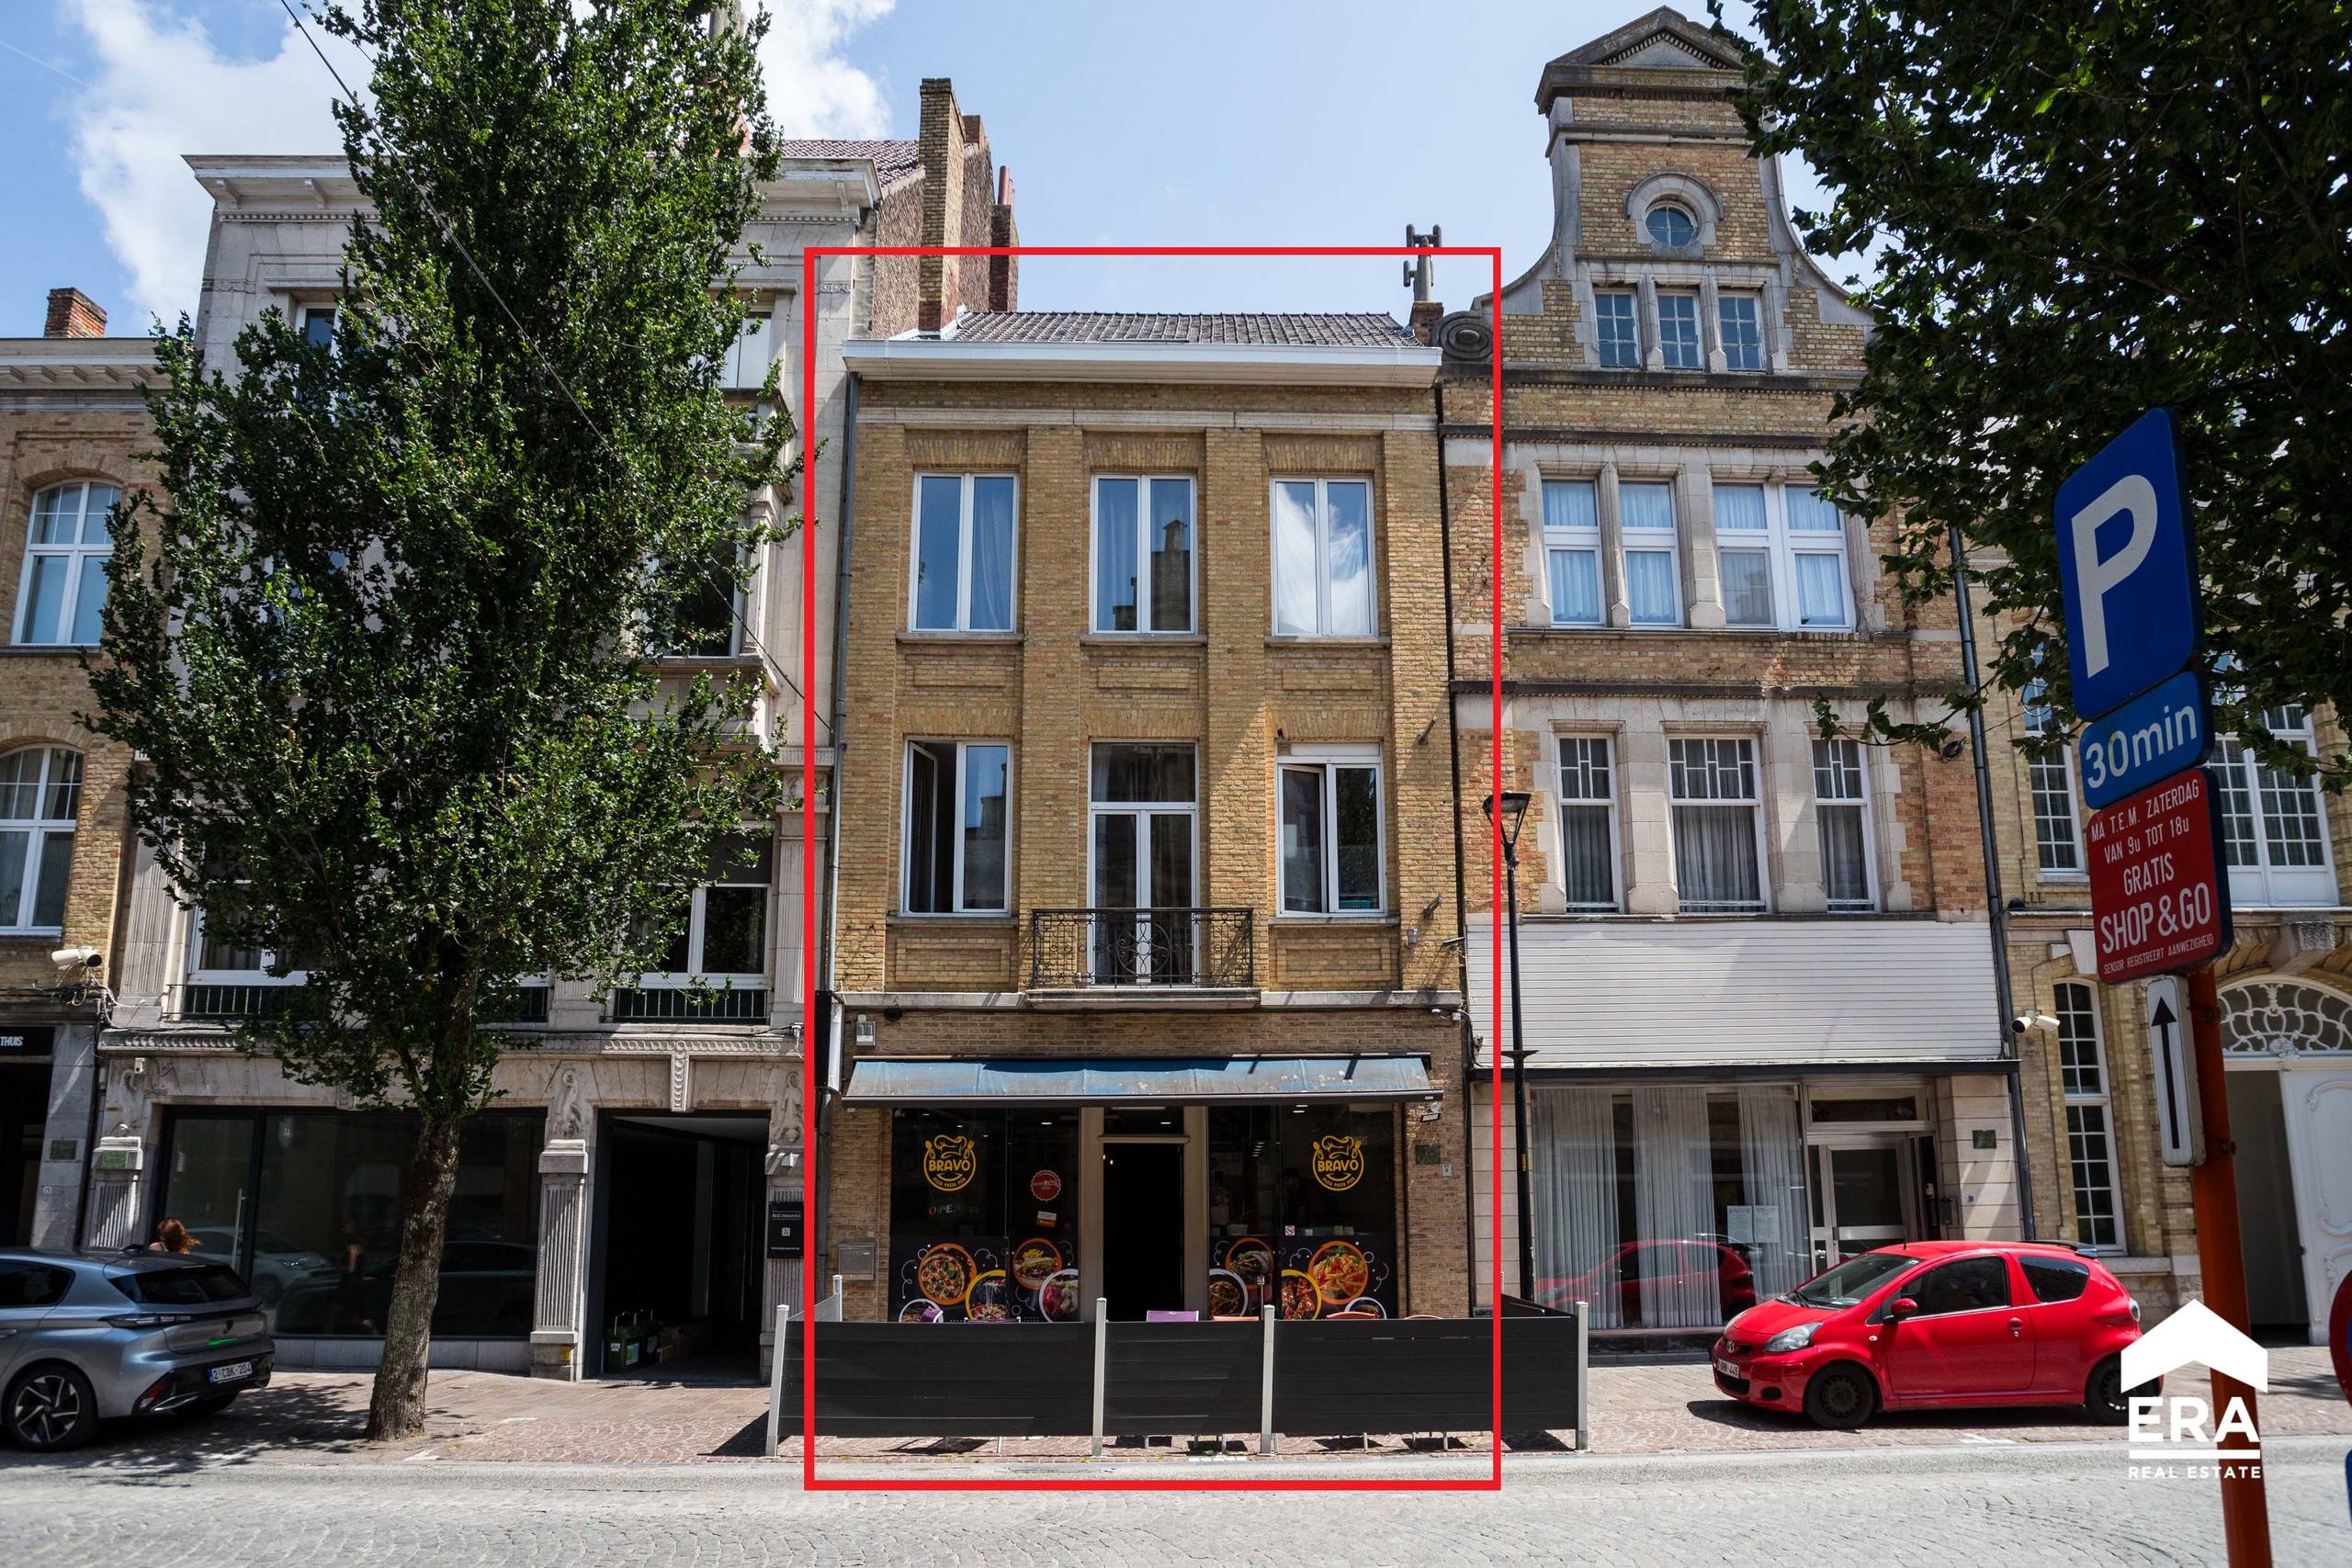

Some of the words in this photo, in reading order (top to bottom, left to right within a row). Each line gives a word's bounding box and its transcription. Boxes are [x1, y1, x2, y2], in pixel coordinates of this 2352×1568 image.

[2071, 474, 2158, 679] P
[2086, 705, 2198, 789] 30min
[2091, 821, 2106, 843] MA
[2109, 807, 2142, 833] T.E.M.
[2146, 779, 2199, 819] ZATERDAG
[2104, 840, 2123, 864] VAN
[2127, 836, 2141, 855] 9u
[2145, 824, 2164, 848] TOT
[2169, 816, 2190, 838] 18u
[2123, 852, 2175, 897] GRATIS
[2104, 961, 2125, 976] SENSOR
[2127, 947, 2165, 969] REGISTREERT
[2168, 933, 2214, 957] AANWEZIGHEID
[929, 1159, 970, 1171] BRAVO
[1317, 1159, 1359, 1171] BRAVO
